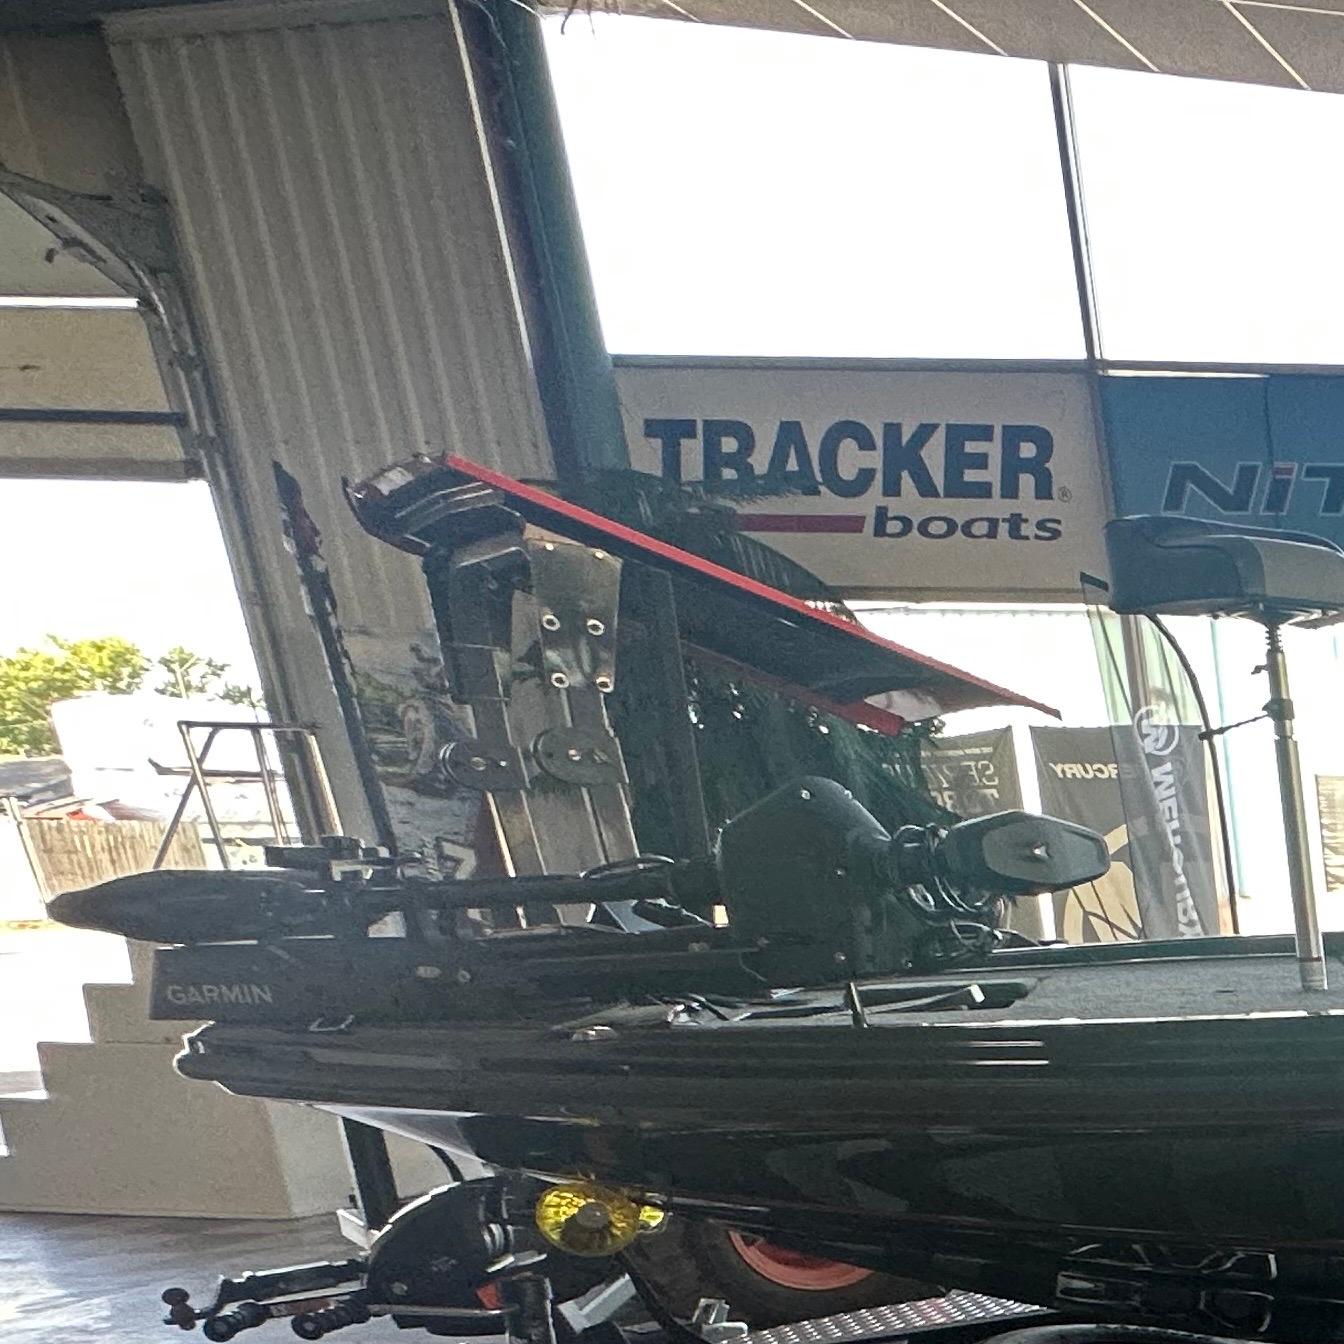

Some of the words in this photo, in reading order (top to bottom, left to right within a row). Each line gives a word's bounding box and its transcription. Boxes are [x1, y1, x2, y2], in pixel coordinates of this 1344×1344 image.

[643, 417, 1055, 501] TRACKER
[872, 505, 1063, 541] boats
[167, 984, 273, 1004] GARMIN
